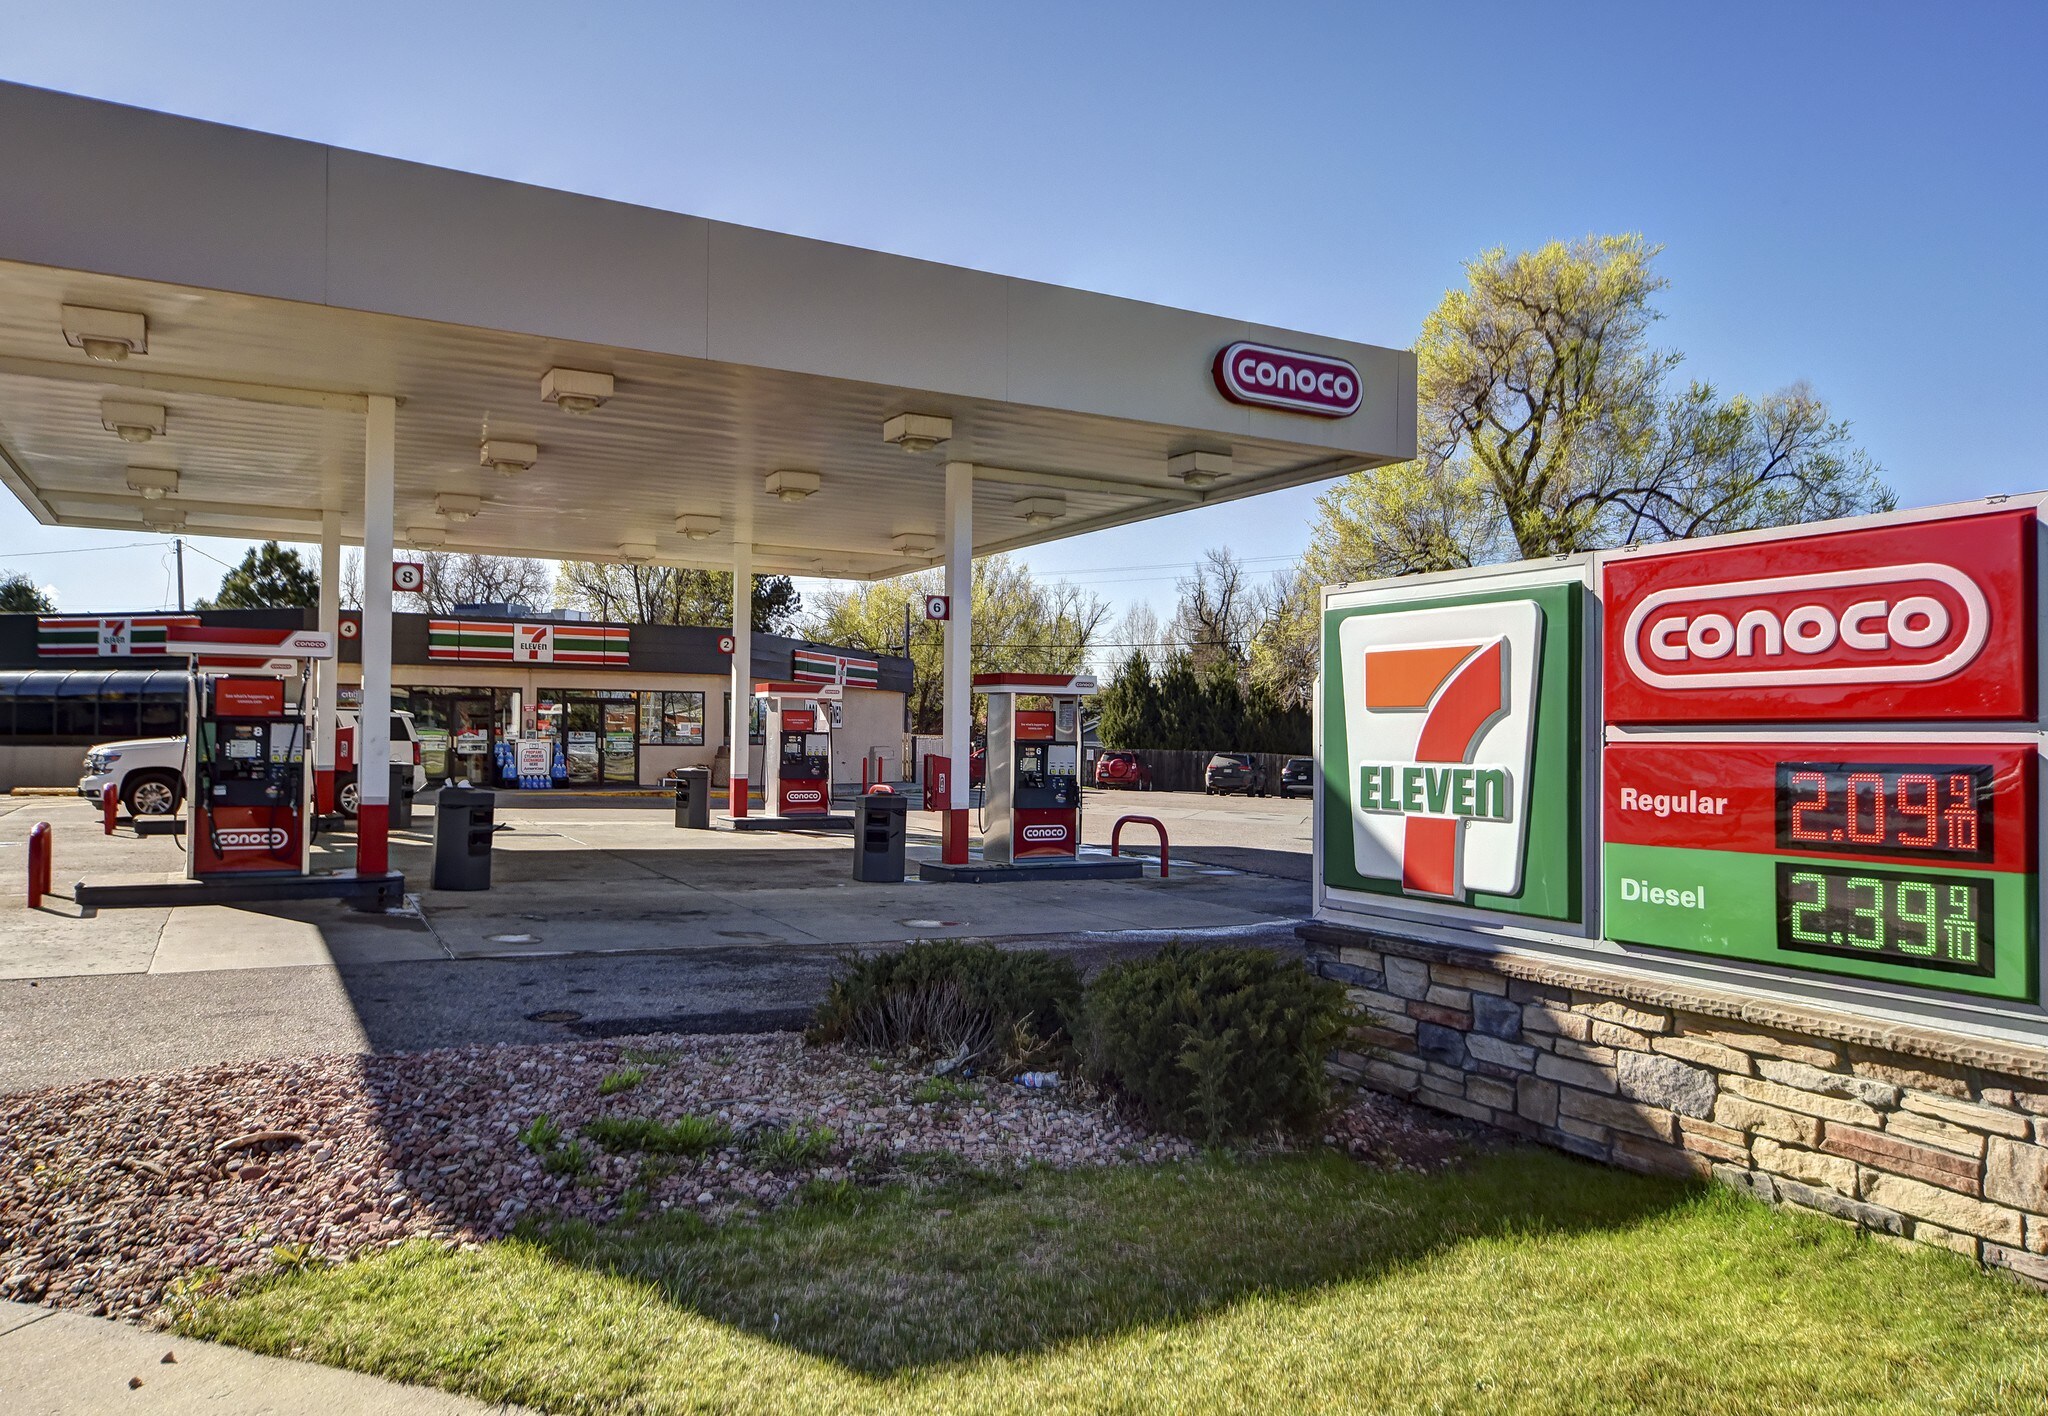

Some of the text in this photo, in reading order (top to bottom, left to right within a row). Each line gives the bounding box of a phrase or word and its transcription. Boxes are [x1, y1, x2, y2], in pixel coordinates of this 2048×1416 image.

[402, 571, 413, 583] 8
[933, 603, 941, 613] 6
[344, 625, 352, 633] 4
[522, 627, 547, 659] 7
[253, 726, 263, 737] 8
[1365, 641, 1502, 896] 7
[1620, 787, 1728, 817] Regular
[1791, 771, 1938, 847] 2.09
[1620, 877, 1705, 909] Diesel
[1791, 872, 1937, 957] 2.39
